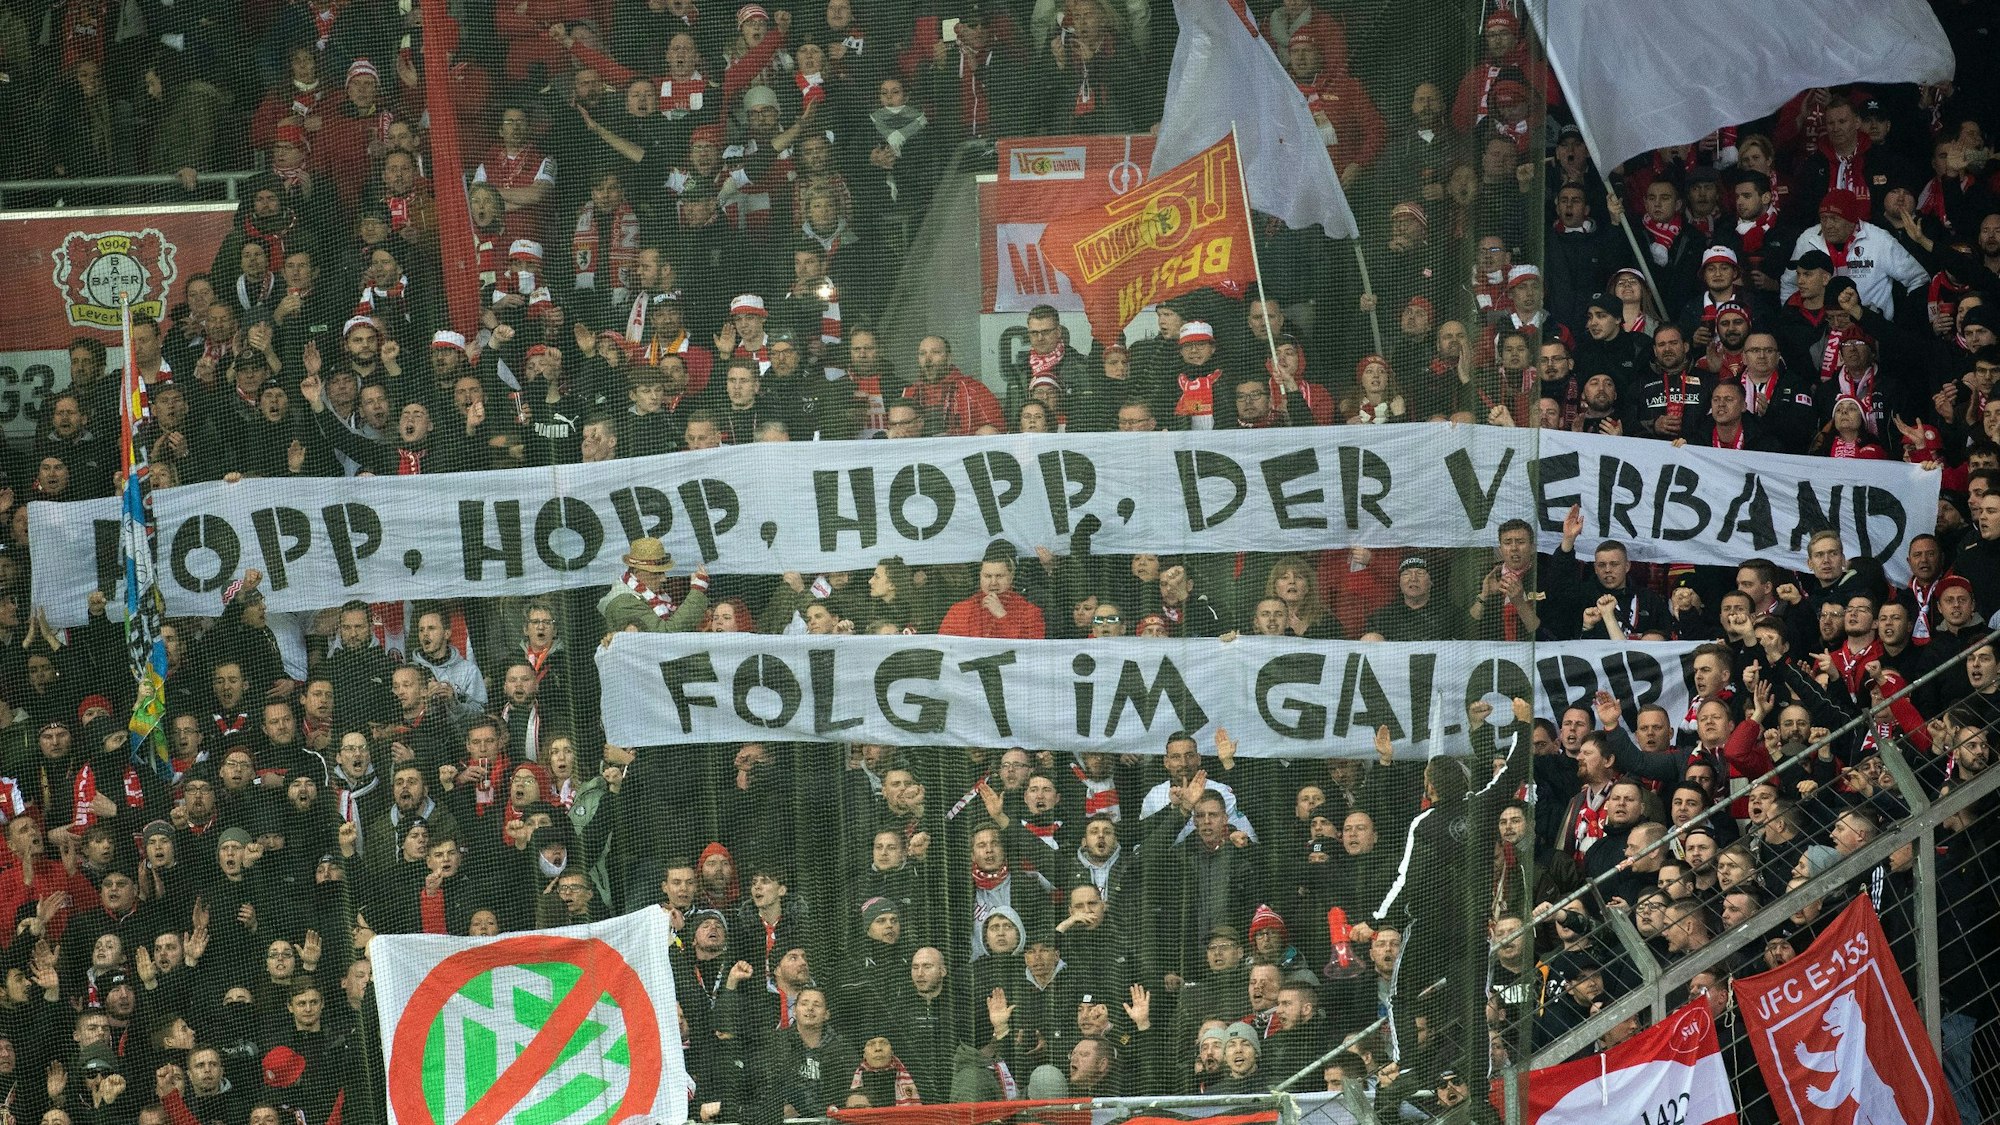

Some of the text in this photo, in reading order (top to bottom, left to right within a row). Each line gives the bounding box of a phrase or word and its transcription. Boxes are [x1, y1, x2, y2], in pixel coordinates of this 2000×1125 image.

[100, 239, 127, 251] 1904
[458, 477, 779, 582] HOPP,
[812, 449, 1136, 553] HOPP,
[1173, 445, 1393, 533] DER
[1443, 446, 1908, 565] VERBAND
[658, 648, 1018, 738] FOLGT
[1804, 931, 1869, 991] E-153
